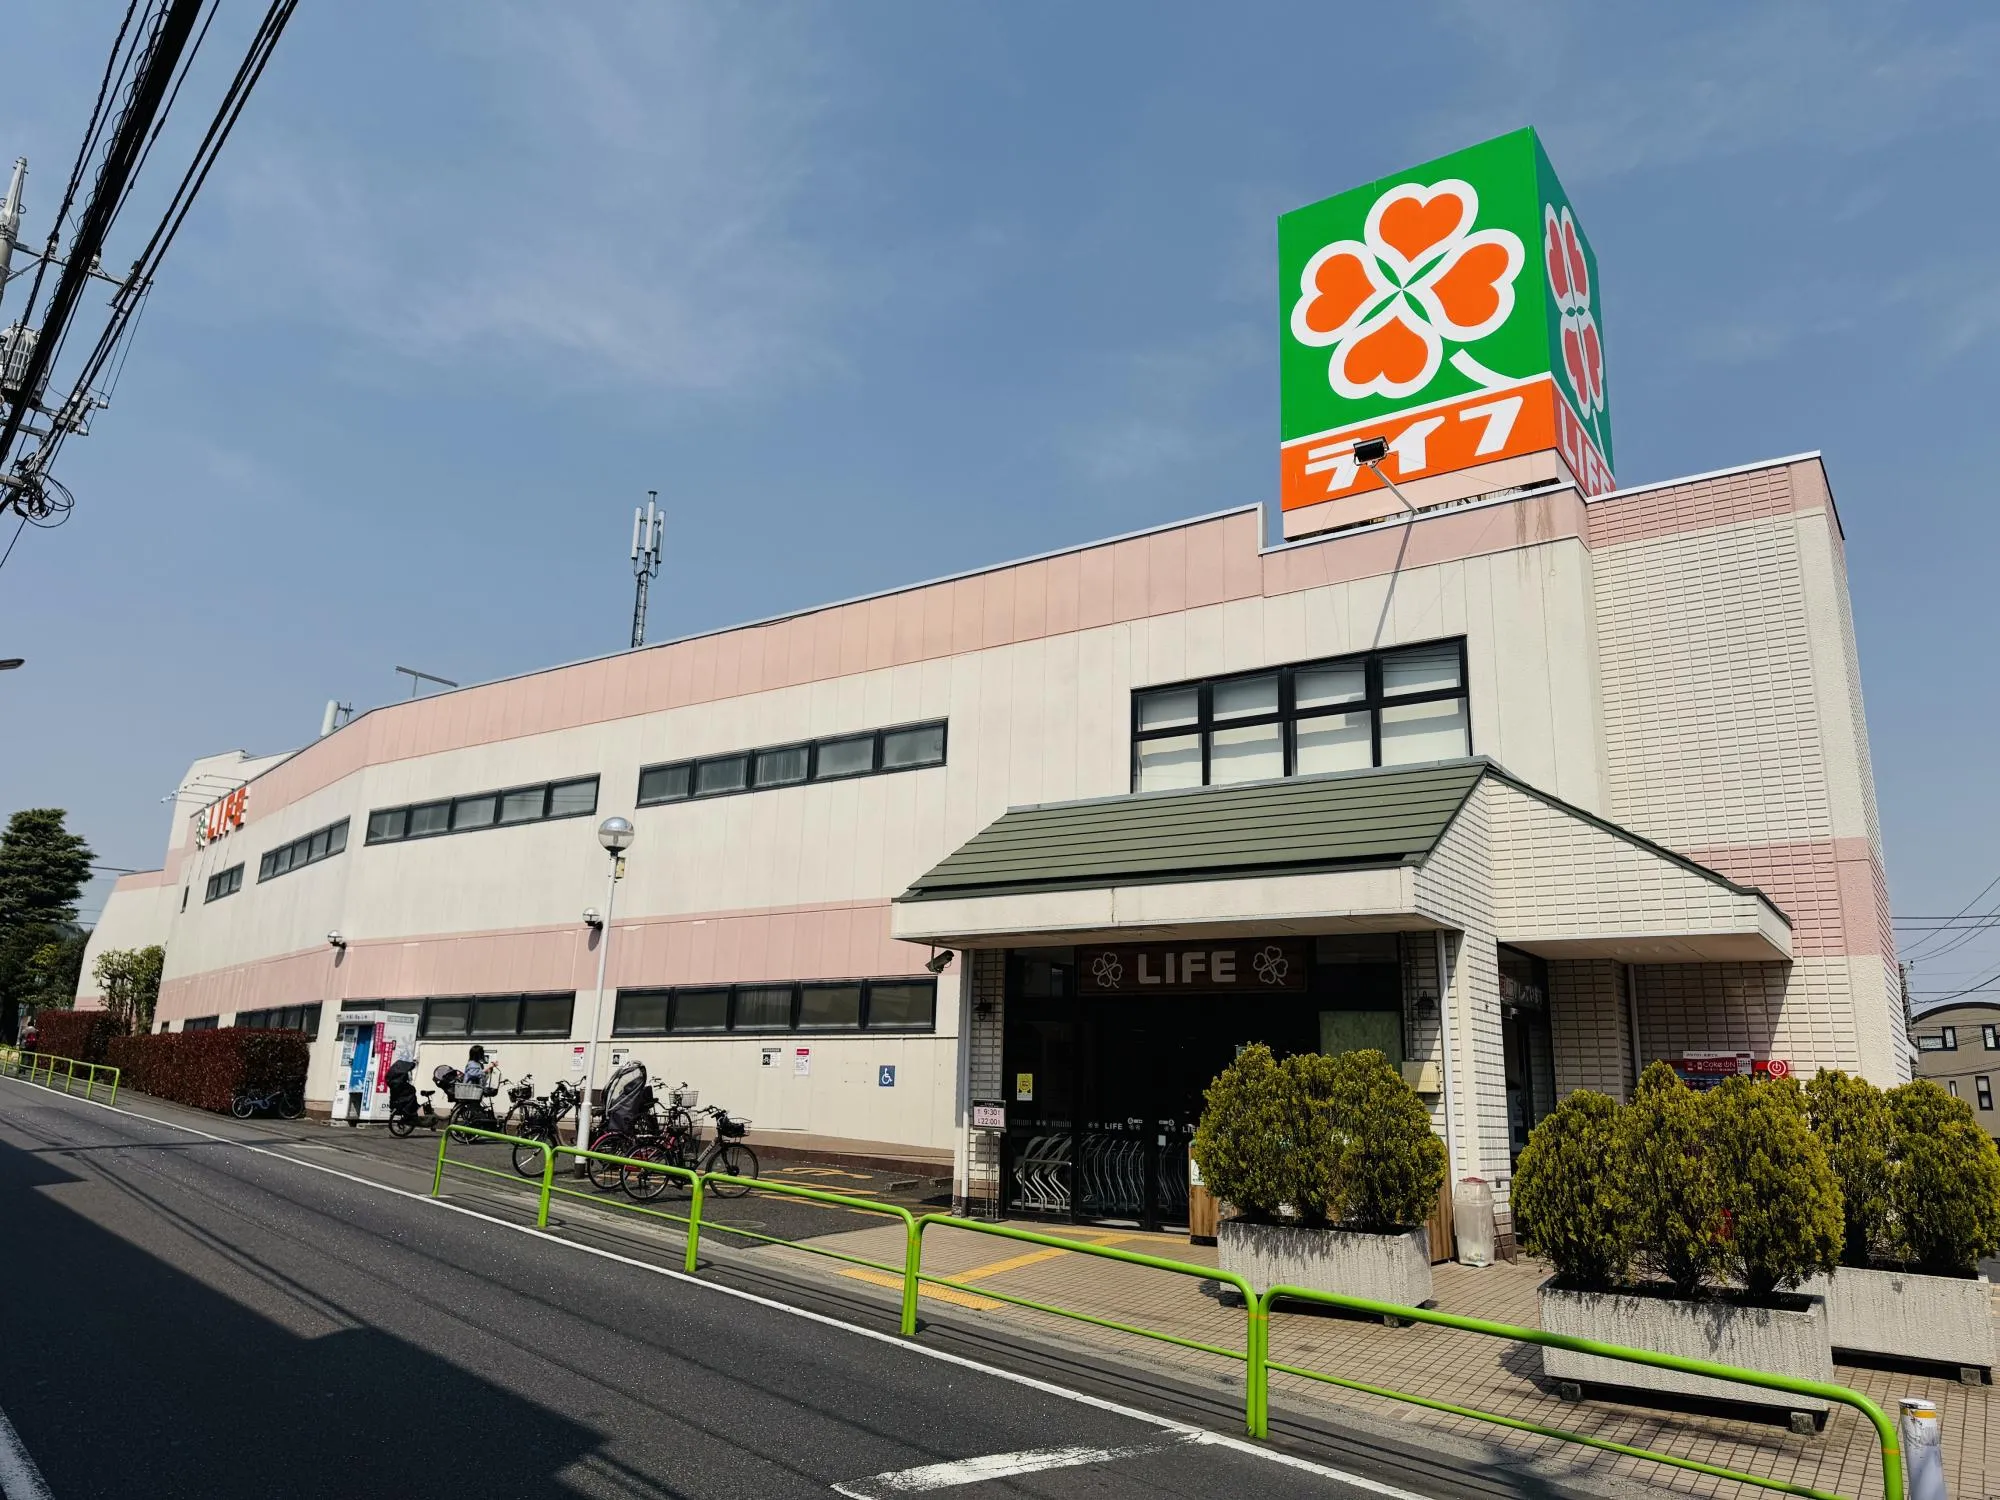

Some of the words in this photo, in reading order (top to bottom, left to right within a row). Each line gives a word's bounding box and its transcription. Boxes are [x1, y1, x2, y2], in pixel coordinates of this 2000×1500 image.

[1305, 395, 1523, 492] ライフ
[207, 786, 248, 839] LIFE
[1138, 950, 1236, 984] LIFE
[1703, 1060, 1723, 1068] Coke
[1104, 1122, 1123, 1130] LIFE
